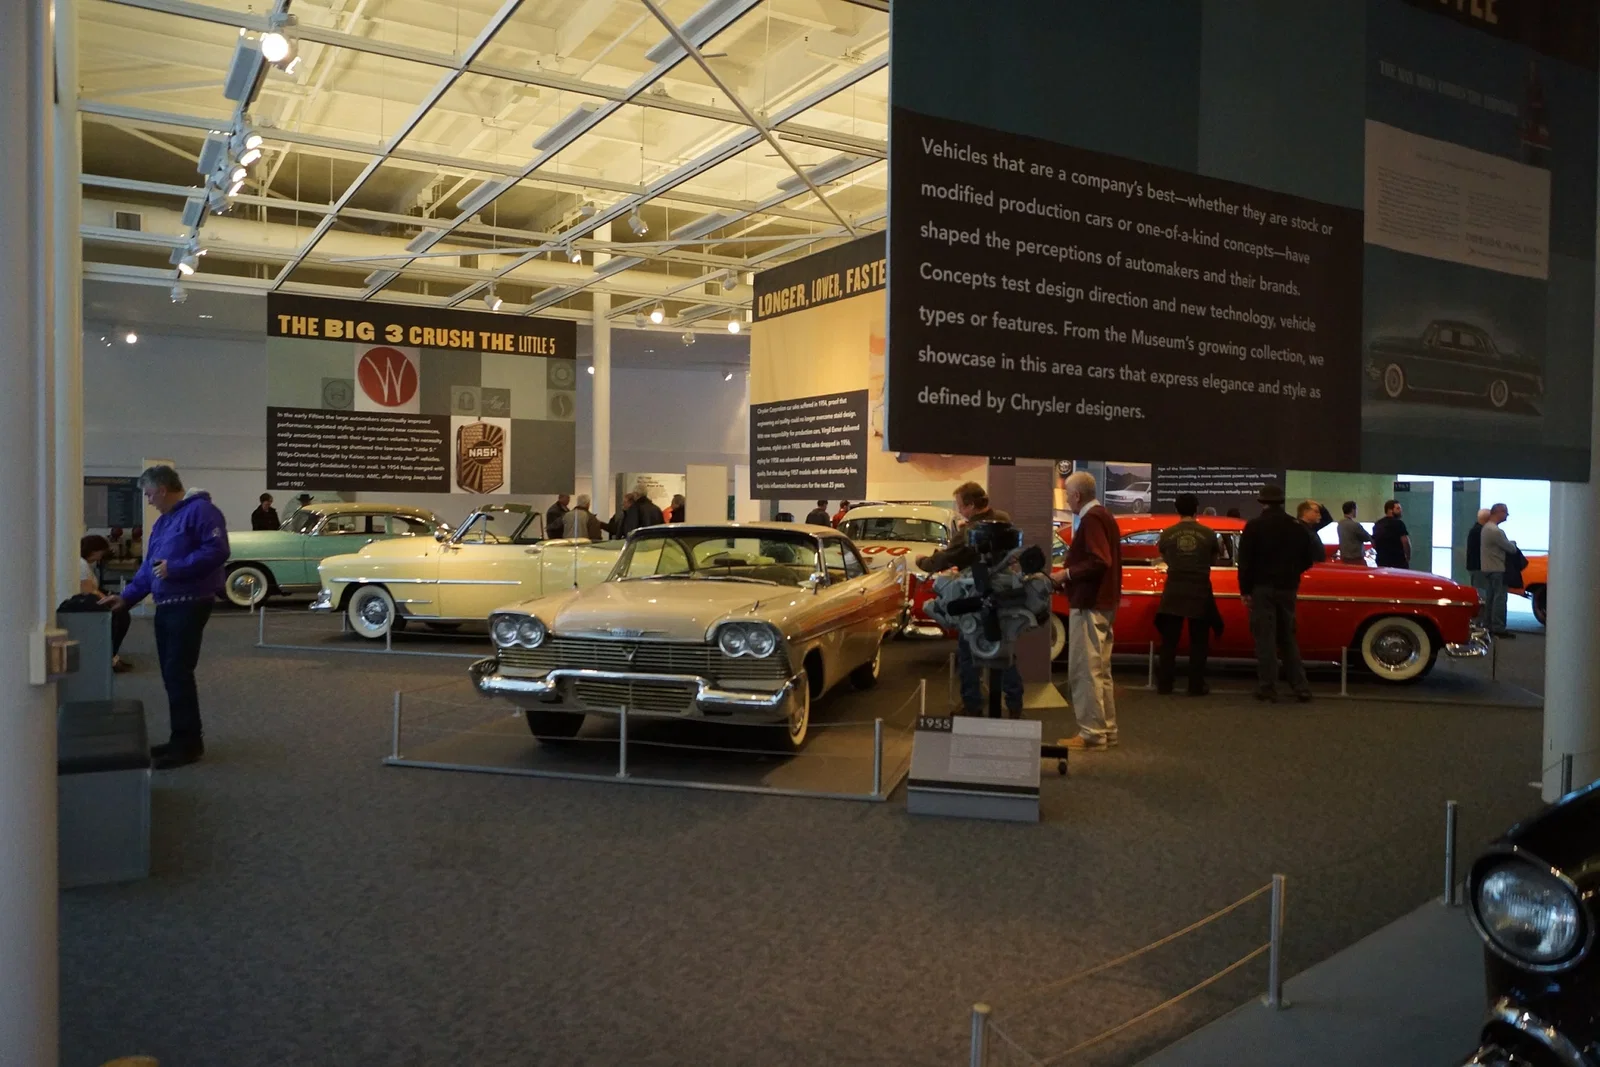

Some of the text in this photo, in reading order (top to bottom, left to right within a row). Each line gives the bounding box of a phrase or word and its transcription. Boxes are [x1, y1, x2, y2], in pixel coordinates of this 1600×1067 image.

[920, 135, 988, 165] Vehicles
[992, 150, 1025, 173] that
[1029, 162, 1054, 178] are
[1057, 168, 1066, 181] a
[1070, 171, 1143, 198] company's
[1241, 202, 1266, 226] they
[1268, 212, 1288, 226] are
[1290, 215, 1319, 232] stock
[1320, 223, 1332, 235] or
[920, 182, 994, 207] modified
[998, 196, 1080, 222] production
[1084, 212, 1113, 228] cars
[1116, 218, 1132, 231] or
[1135, 222, 1220, 248] one-of-a-kind
[919, 219, 1301, 296] shaped the perceptions of automakers and their brands.
[758, 283, 809, 317] LONGER,
[811, 273, 843, 303] LOWER,
[918, 261, 996, 290] Concepts
[1001, 274, 1030, 293] test
[1034, 277, 1084, 303] design
[1088, 284, 1148, 308] direction
[1152, 296, 1176, 312] and
[1179, 302, 1207, 316] new
[1279, 313, 1316, 332] vehicle
[278, 315, 556, 355] THE BIG 3 CRUSH THE LITTLE 5
[917, 304, 965, 327] types
[969, 313, 987, 326] or
[991, 310, 1057, 335] features.
[1062, 319, 1100, 340] From
[1104, 324, 1127, 343] the
[1130, 328, 1194, 351] Museum's
[1197, 339, 1247, 361] growing
[1307, 354, 1324, 366] we
[365, 356, 408, 403] W
[917, 343, 1321, 400] showcase in this area cars that express elegance and style as
[916, 384, 1144, 421] defined by Chrysler designers.
[469, 448, 497, 457] NASH
[858, 545, 912, 556] 00
